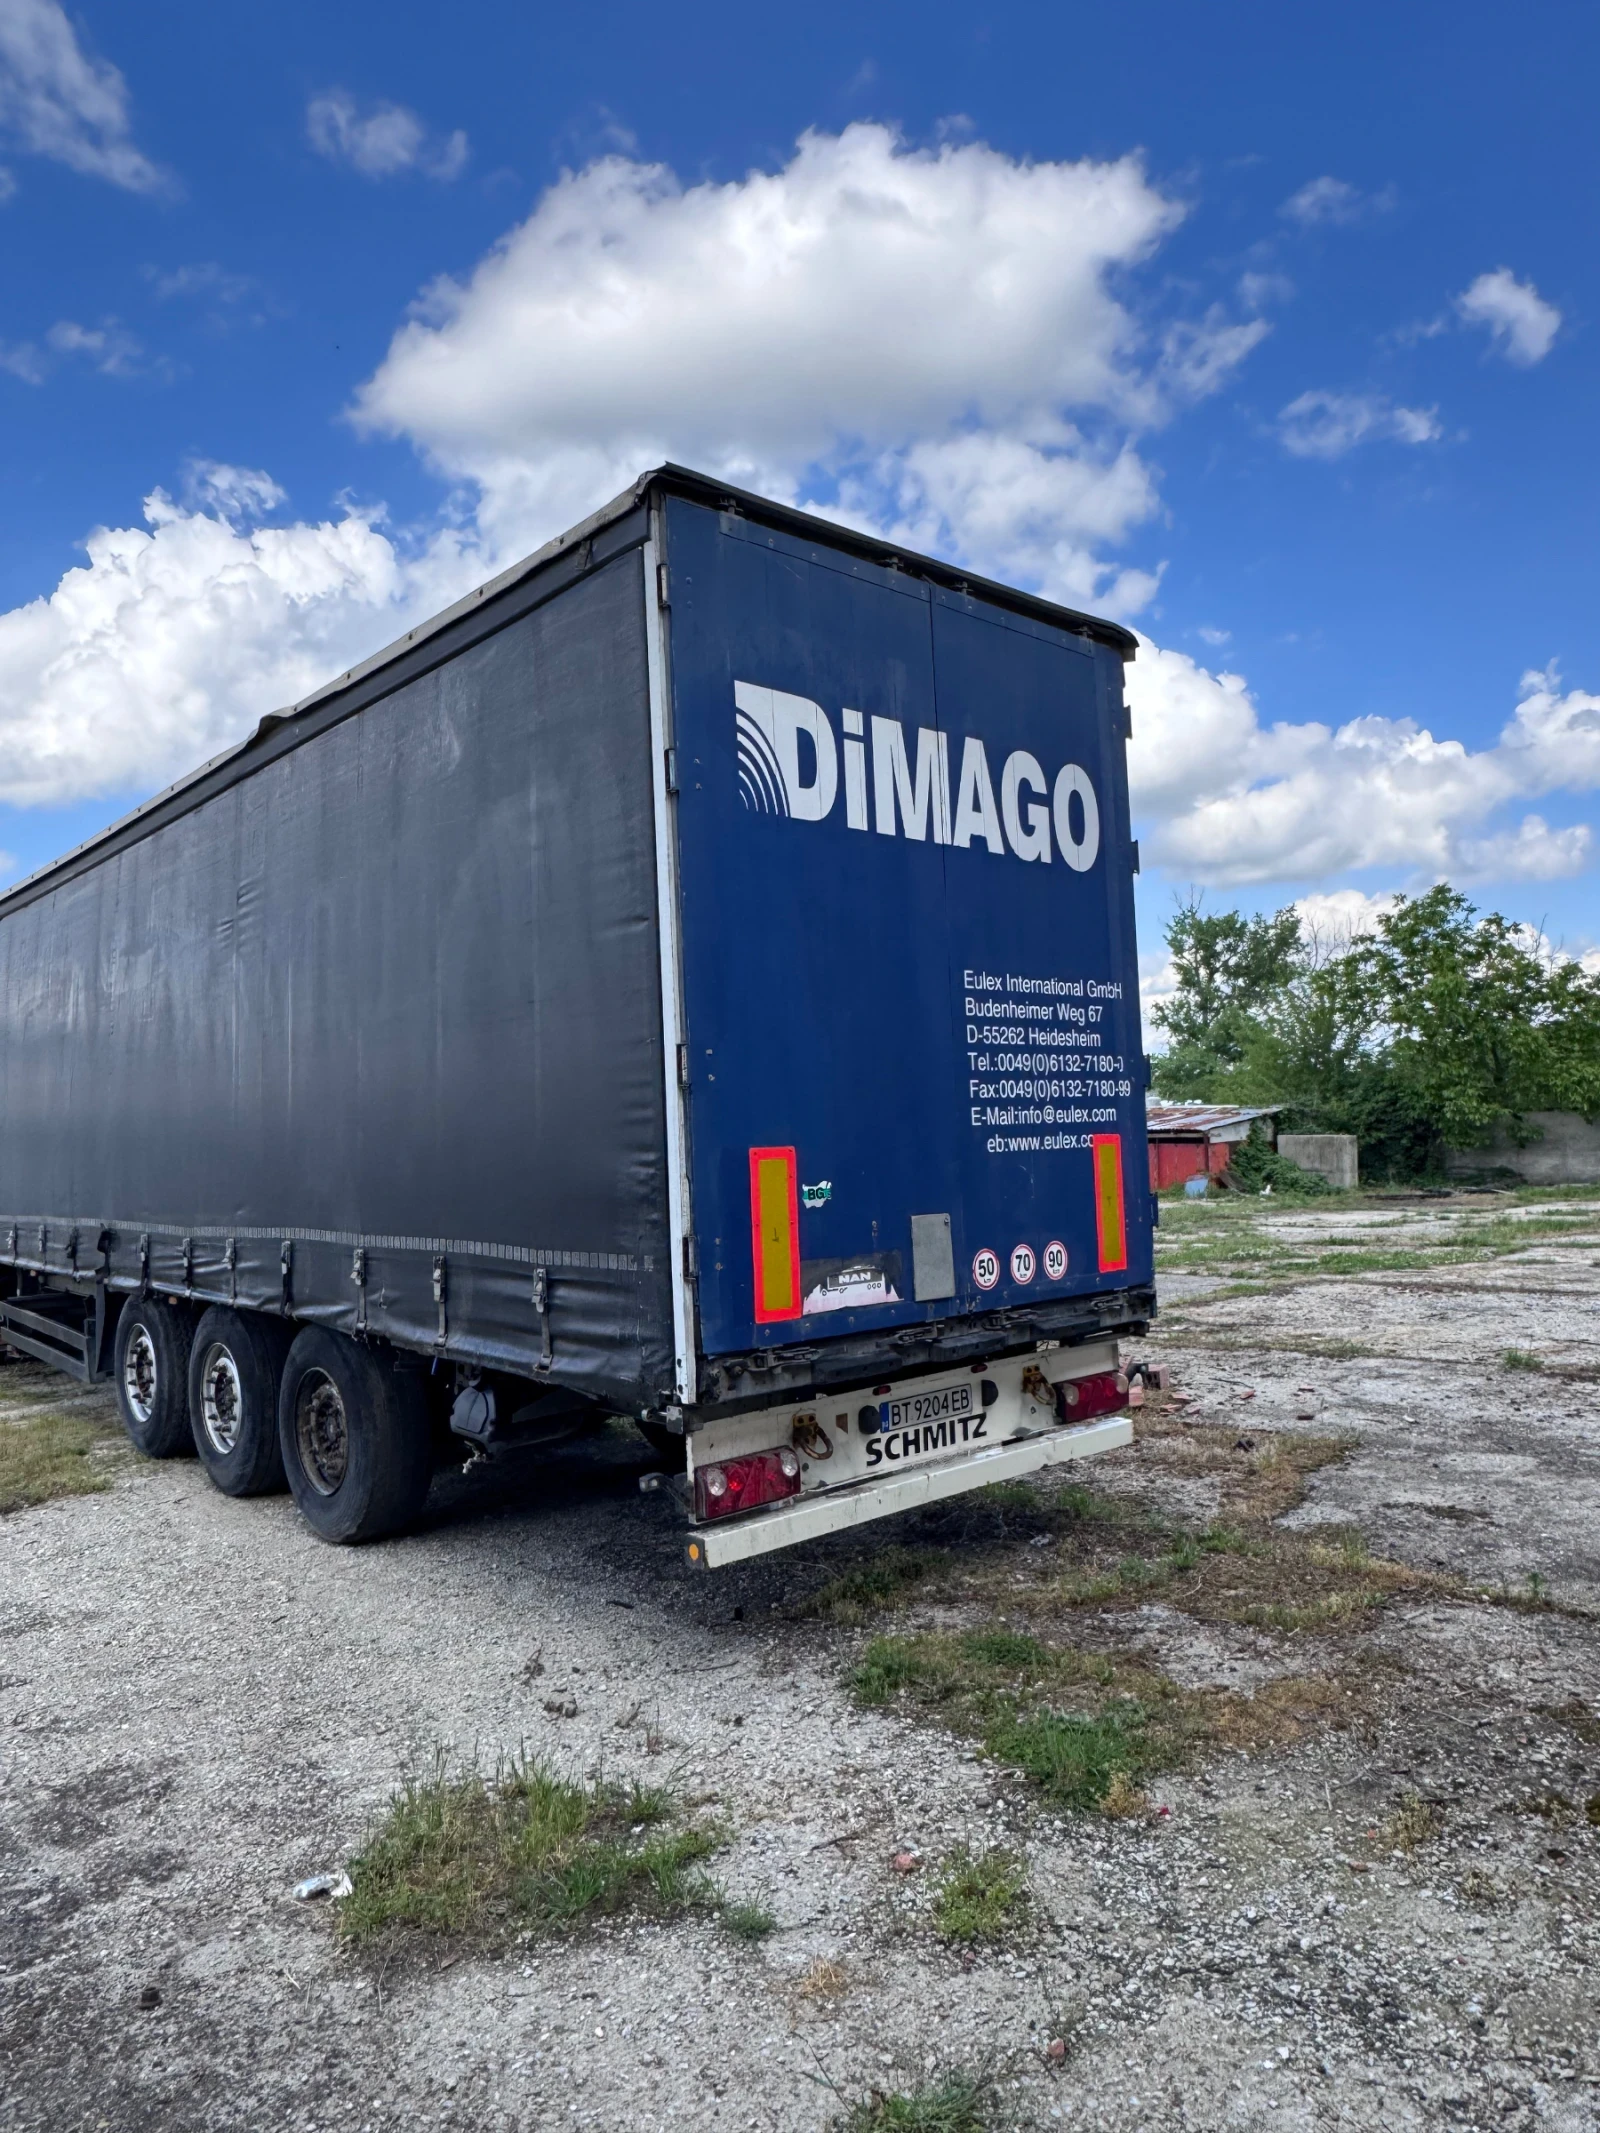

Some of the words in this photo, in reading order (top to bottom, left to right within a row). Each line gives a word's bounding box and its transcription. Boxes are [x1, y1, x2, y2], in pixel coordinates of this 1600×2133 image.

[734, 680, 1100, 872] DiMAGO
[963, 970, 1003, 991] Eulex
[1006, 973, 1084, 997] International
[1087, 979, 1123, 1000] GmbH
[965, 998, 1054, 1020] Budenheimer
[1056, 1003, 1085, 1026] Weg
[1088, 1006, 1103, 1022] 67
[966, 1024, 1026, 1046] D-55262
[1028, 1027, 1101, 1047] Heidesheim
[970, 1105, 1117, 1127] E-Mail:info@eulex.com
[978, 1257, 995, 1278] 50
[1015, 1253, 1031, 1273] 70
[1048, 1249, 1063, 1268] 90
[891, 1401, 912, 1426] BT
[914, 1392, 949, 1421] 9204
[951, 1388, 970, 1412] EB
[865, 1412, 988, 1467] SCHMITZ
